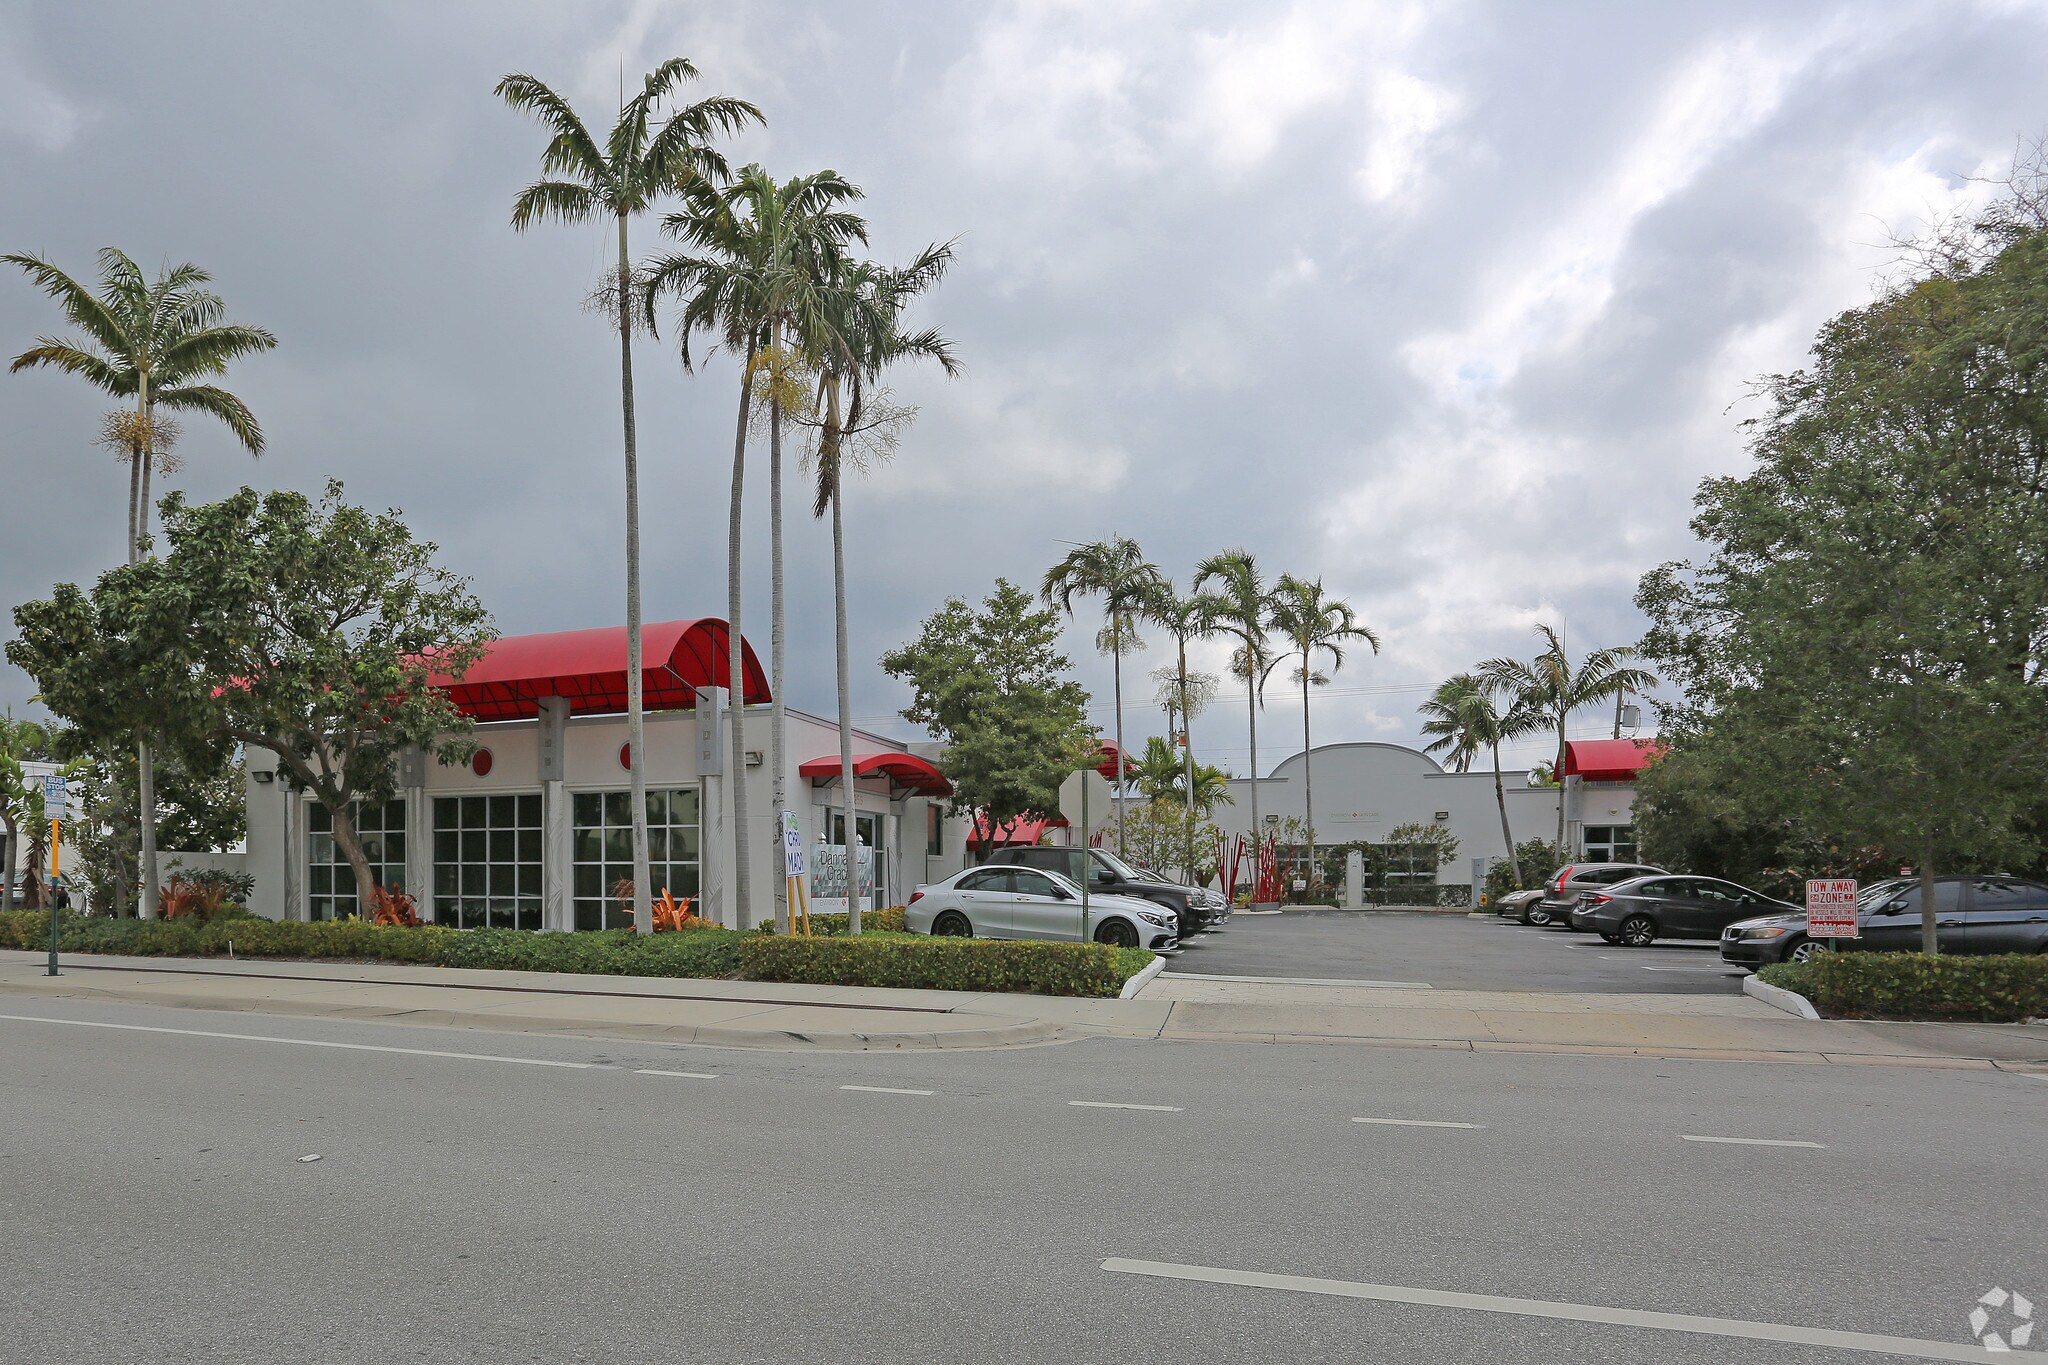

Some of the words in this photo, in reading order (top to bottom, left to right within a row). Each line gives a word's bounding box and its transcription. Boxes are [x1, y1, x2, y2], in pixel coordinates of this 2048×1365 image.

[1810, 882, 1827, 892] TOW
[1831, 882, 1853, 892] AWAY
[1820, 893, 1843, 903] ZONE
